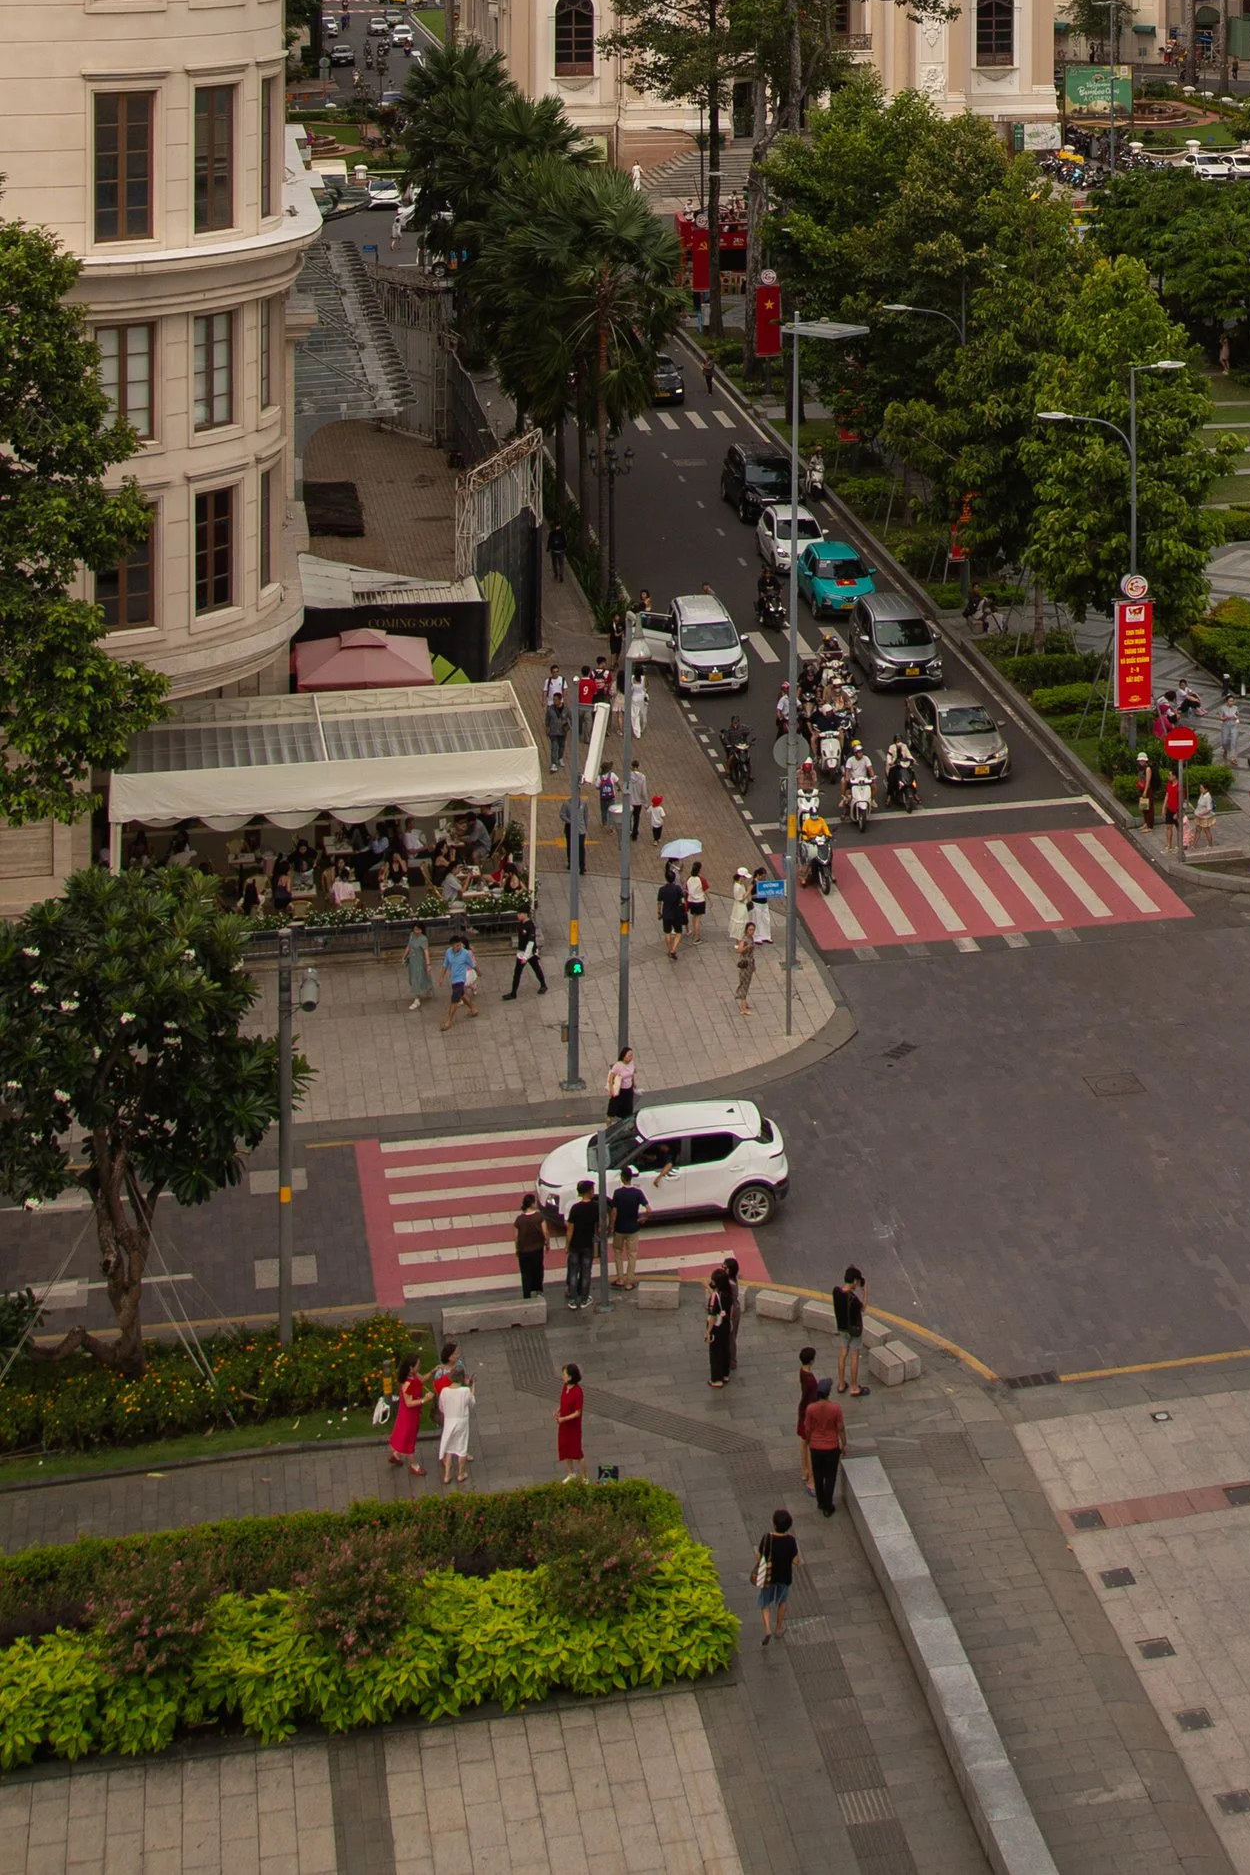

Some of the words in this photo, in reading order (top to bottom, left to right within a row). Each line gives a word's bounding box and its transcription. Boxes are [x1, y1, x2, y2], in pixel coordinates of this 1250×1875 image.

[368, 617, 416, 628] COMING
[419, 617, 451, 628] SOON
[583, 686, 589, 695] 9
